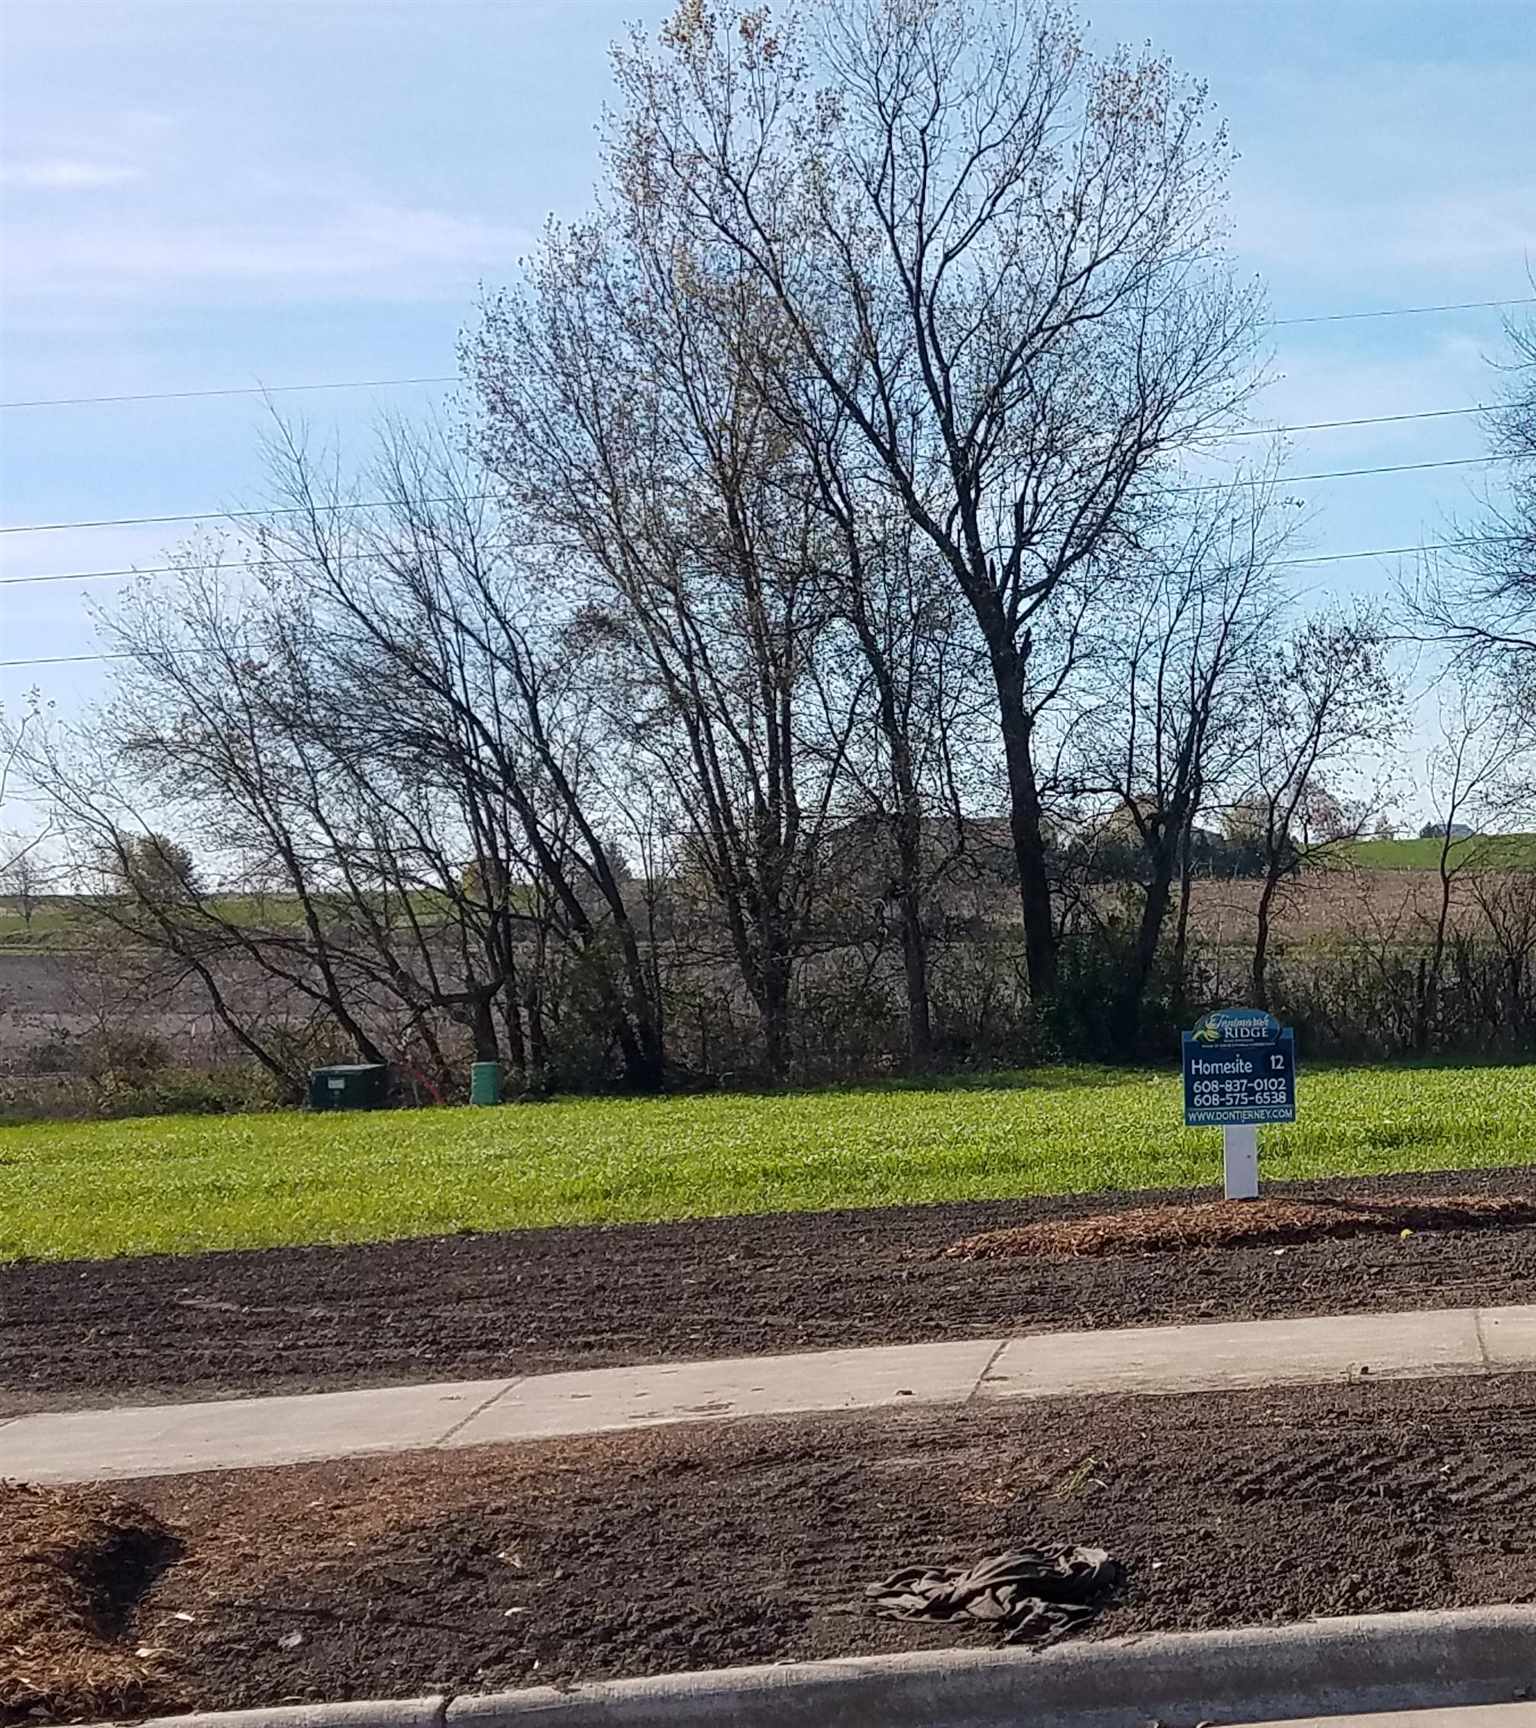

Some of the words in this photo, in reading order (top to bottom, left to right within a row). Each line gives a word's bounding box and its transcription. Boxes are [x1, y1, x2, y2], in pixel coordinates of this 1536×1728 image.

[1224, 1027, 1269, 1039] RIDGE
[1191, 1053, 1253, 1075] Homesite
[1270, 1054, 1285, 1070] 12
[1193, 1078, 1287, 1093] 608-837-0102
[1193, 1091, 1287, 1107] 608-575-6538
[1188, 1108, 1293, 1121] WWW.DONTIERNEY.COM
